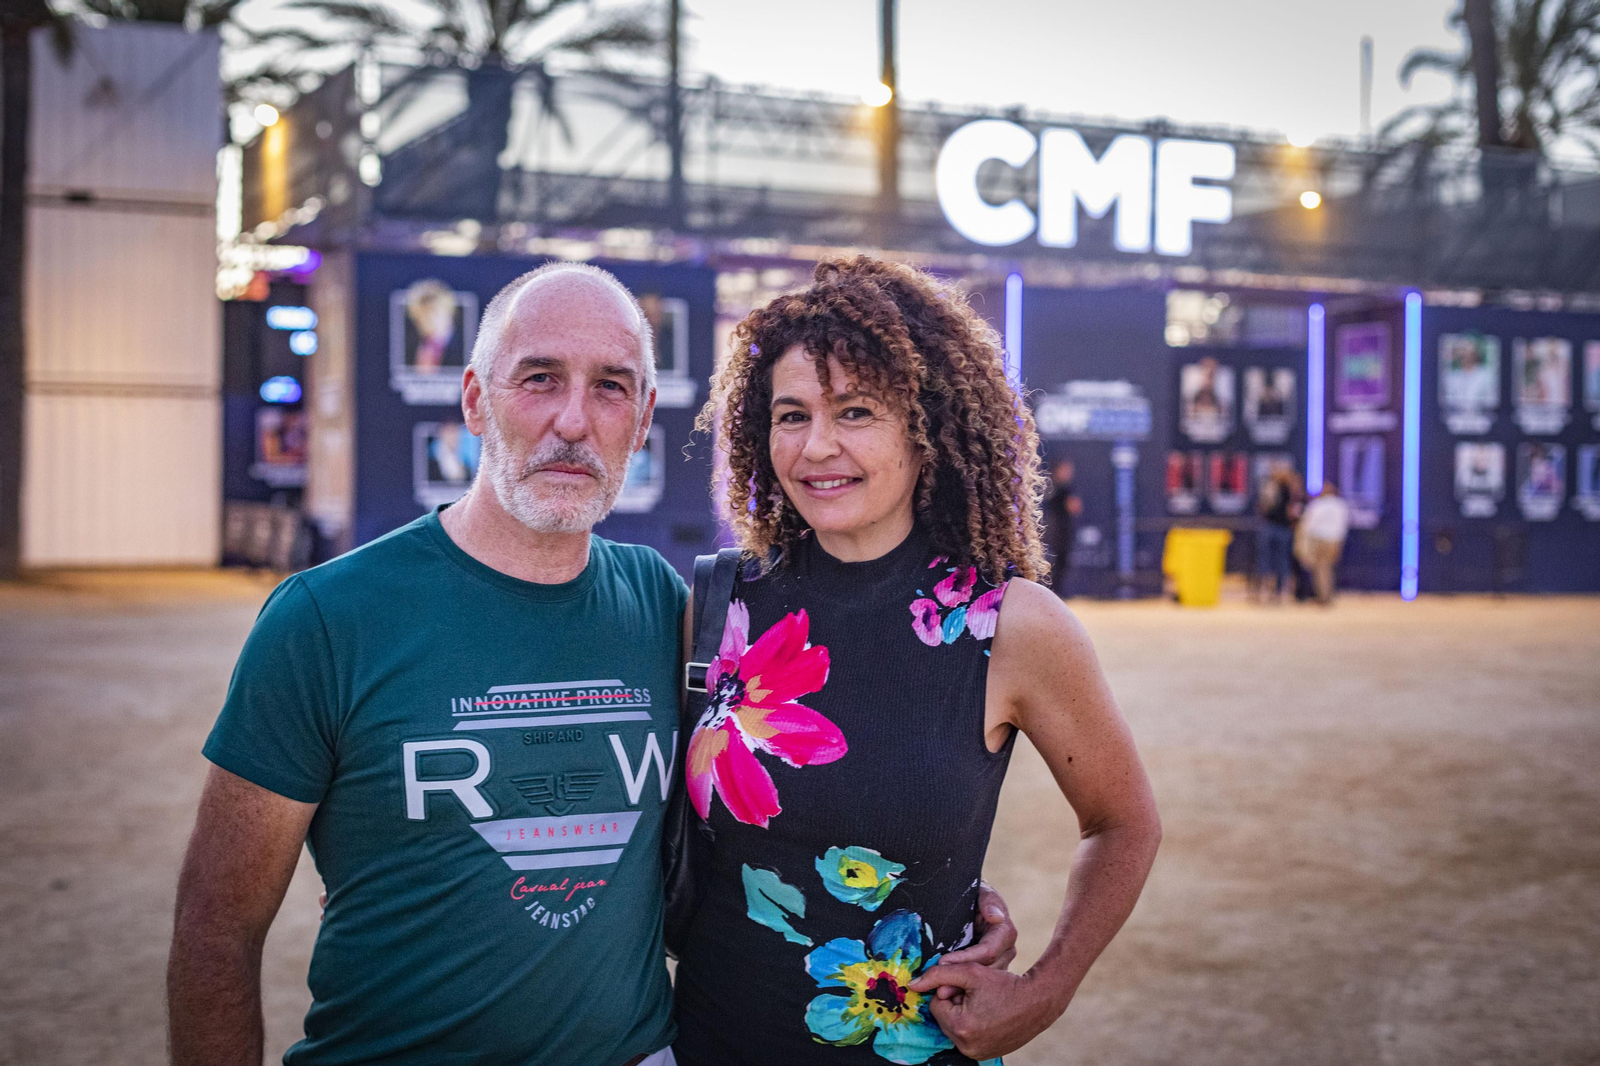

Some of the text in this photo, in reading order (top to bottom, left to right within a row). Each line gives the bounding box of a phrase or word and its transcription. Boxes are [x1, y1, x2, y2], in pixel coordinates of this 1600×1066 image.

[936, 119, 1236, 257] CMF
[451, 688, 651, 713] INNOVATIVE PROCESS
[506, 822, 619, 841] JEANSWEAR
[510, 876, 570, 900] Casual
